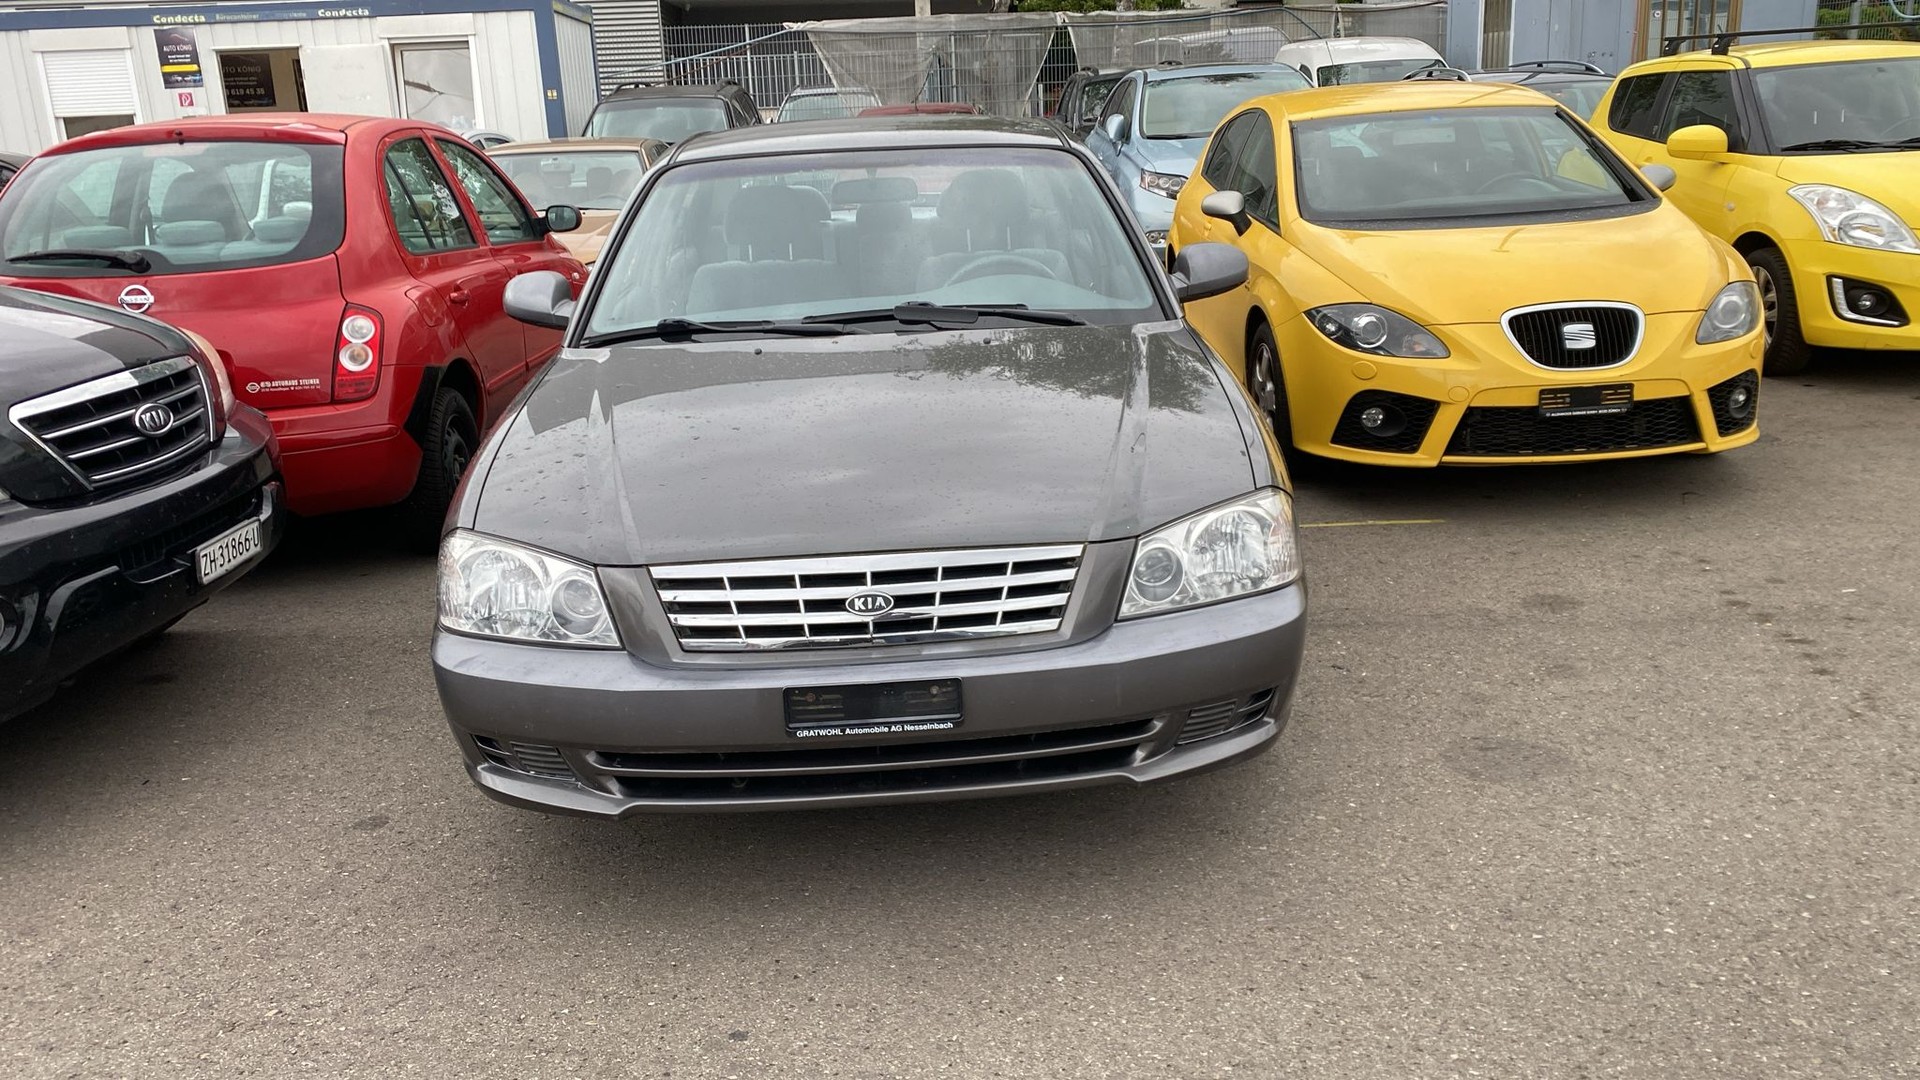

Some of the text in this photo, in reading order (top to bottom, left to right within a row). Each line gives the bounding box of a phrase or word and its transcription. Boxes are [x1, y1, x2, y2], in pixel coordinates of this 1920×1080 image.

[317, 7, 370, 17] Condecta
[153, 14, 206, 24] Condecta
[853, 596, 887, 610] KIA
[796, 721, 954, 738] GRATWOHL Automobile AG Nesselnbach
